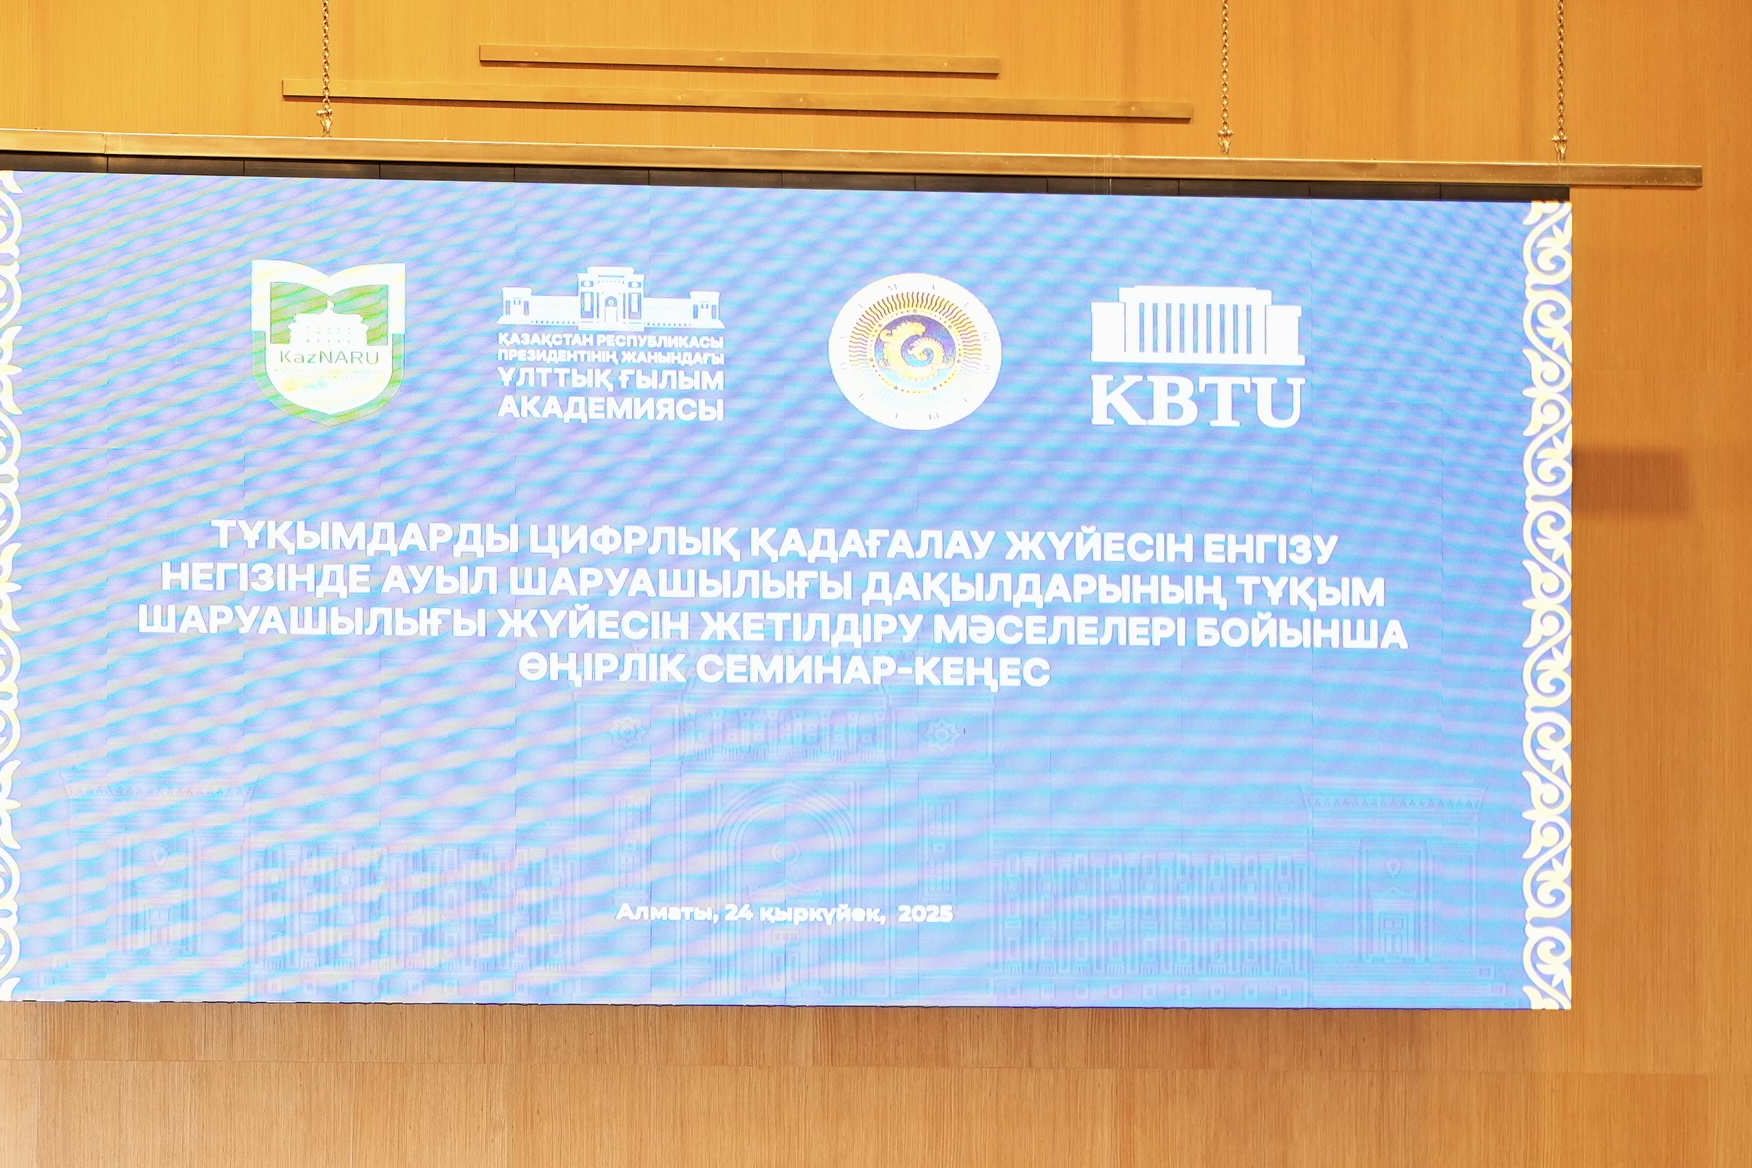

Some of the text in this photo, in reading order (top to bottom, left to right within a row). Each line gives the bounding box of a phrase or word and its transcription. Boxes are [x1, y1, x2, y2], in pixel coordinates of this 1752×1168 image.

[498, 332, 724, 349] ҚАЗАҚСТАН РЕСПУБЛИКАСЫ
[279, 350, 379, 365] KazNARU
[498, 348, 725, 366] ПРЕЗИДЕНТІНІҢ ЖАНЫНДАҒЫ
[497, 366, 725, 392] ҰЛТТЫҚ ҒЫЛЫМ
[497, 395, 724, 424] АКАДЕМИЯСЫ
[1091, 374, 1306, 428] KBTU
[211, 519, 1339, 565] ТҰҚЫМДАРДЫ ЦИФРЛЫҚ ҚАДАҒАЛАУ ЖҮЙЕСІН ЕНГІЗУ
[162, 562, 1385, 612] НЕГІЗІНДЕ АУЫЛ ШАРУАШЫЛЫҒЫ ДАҚЫЛДАРЫНЫҢ ТҰҚЫМ
[138, 604, 1409, 649] ШАРУАШЫЛЫҒЫ ЖҮЙЕСІН ЖЕТІЛДІРУ МӘСЕЛЕЛЕРІ БОЙЫНША
[518, 651, 1051, 692] ӨҢІРЛІК СЕМИНАР-КЕҢЕС
[615, 902, 954, 926] Алматы, 24 қыркүйек, 2025
